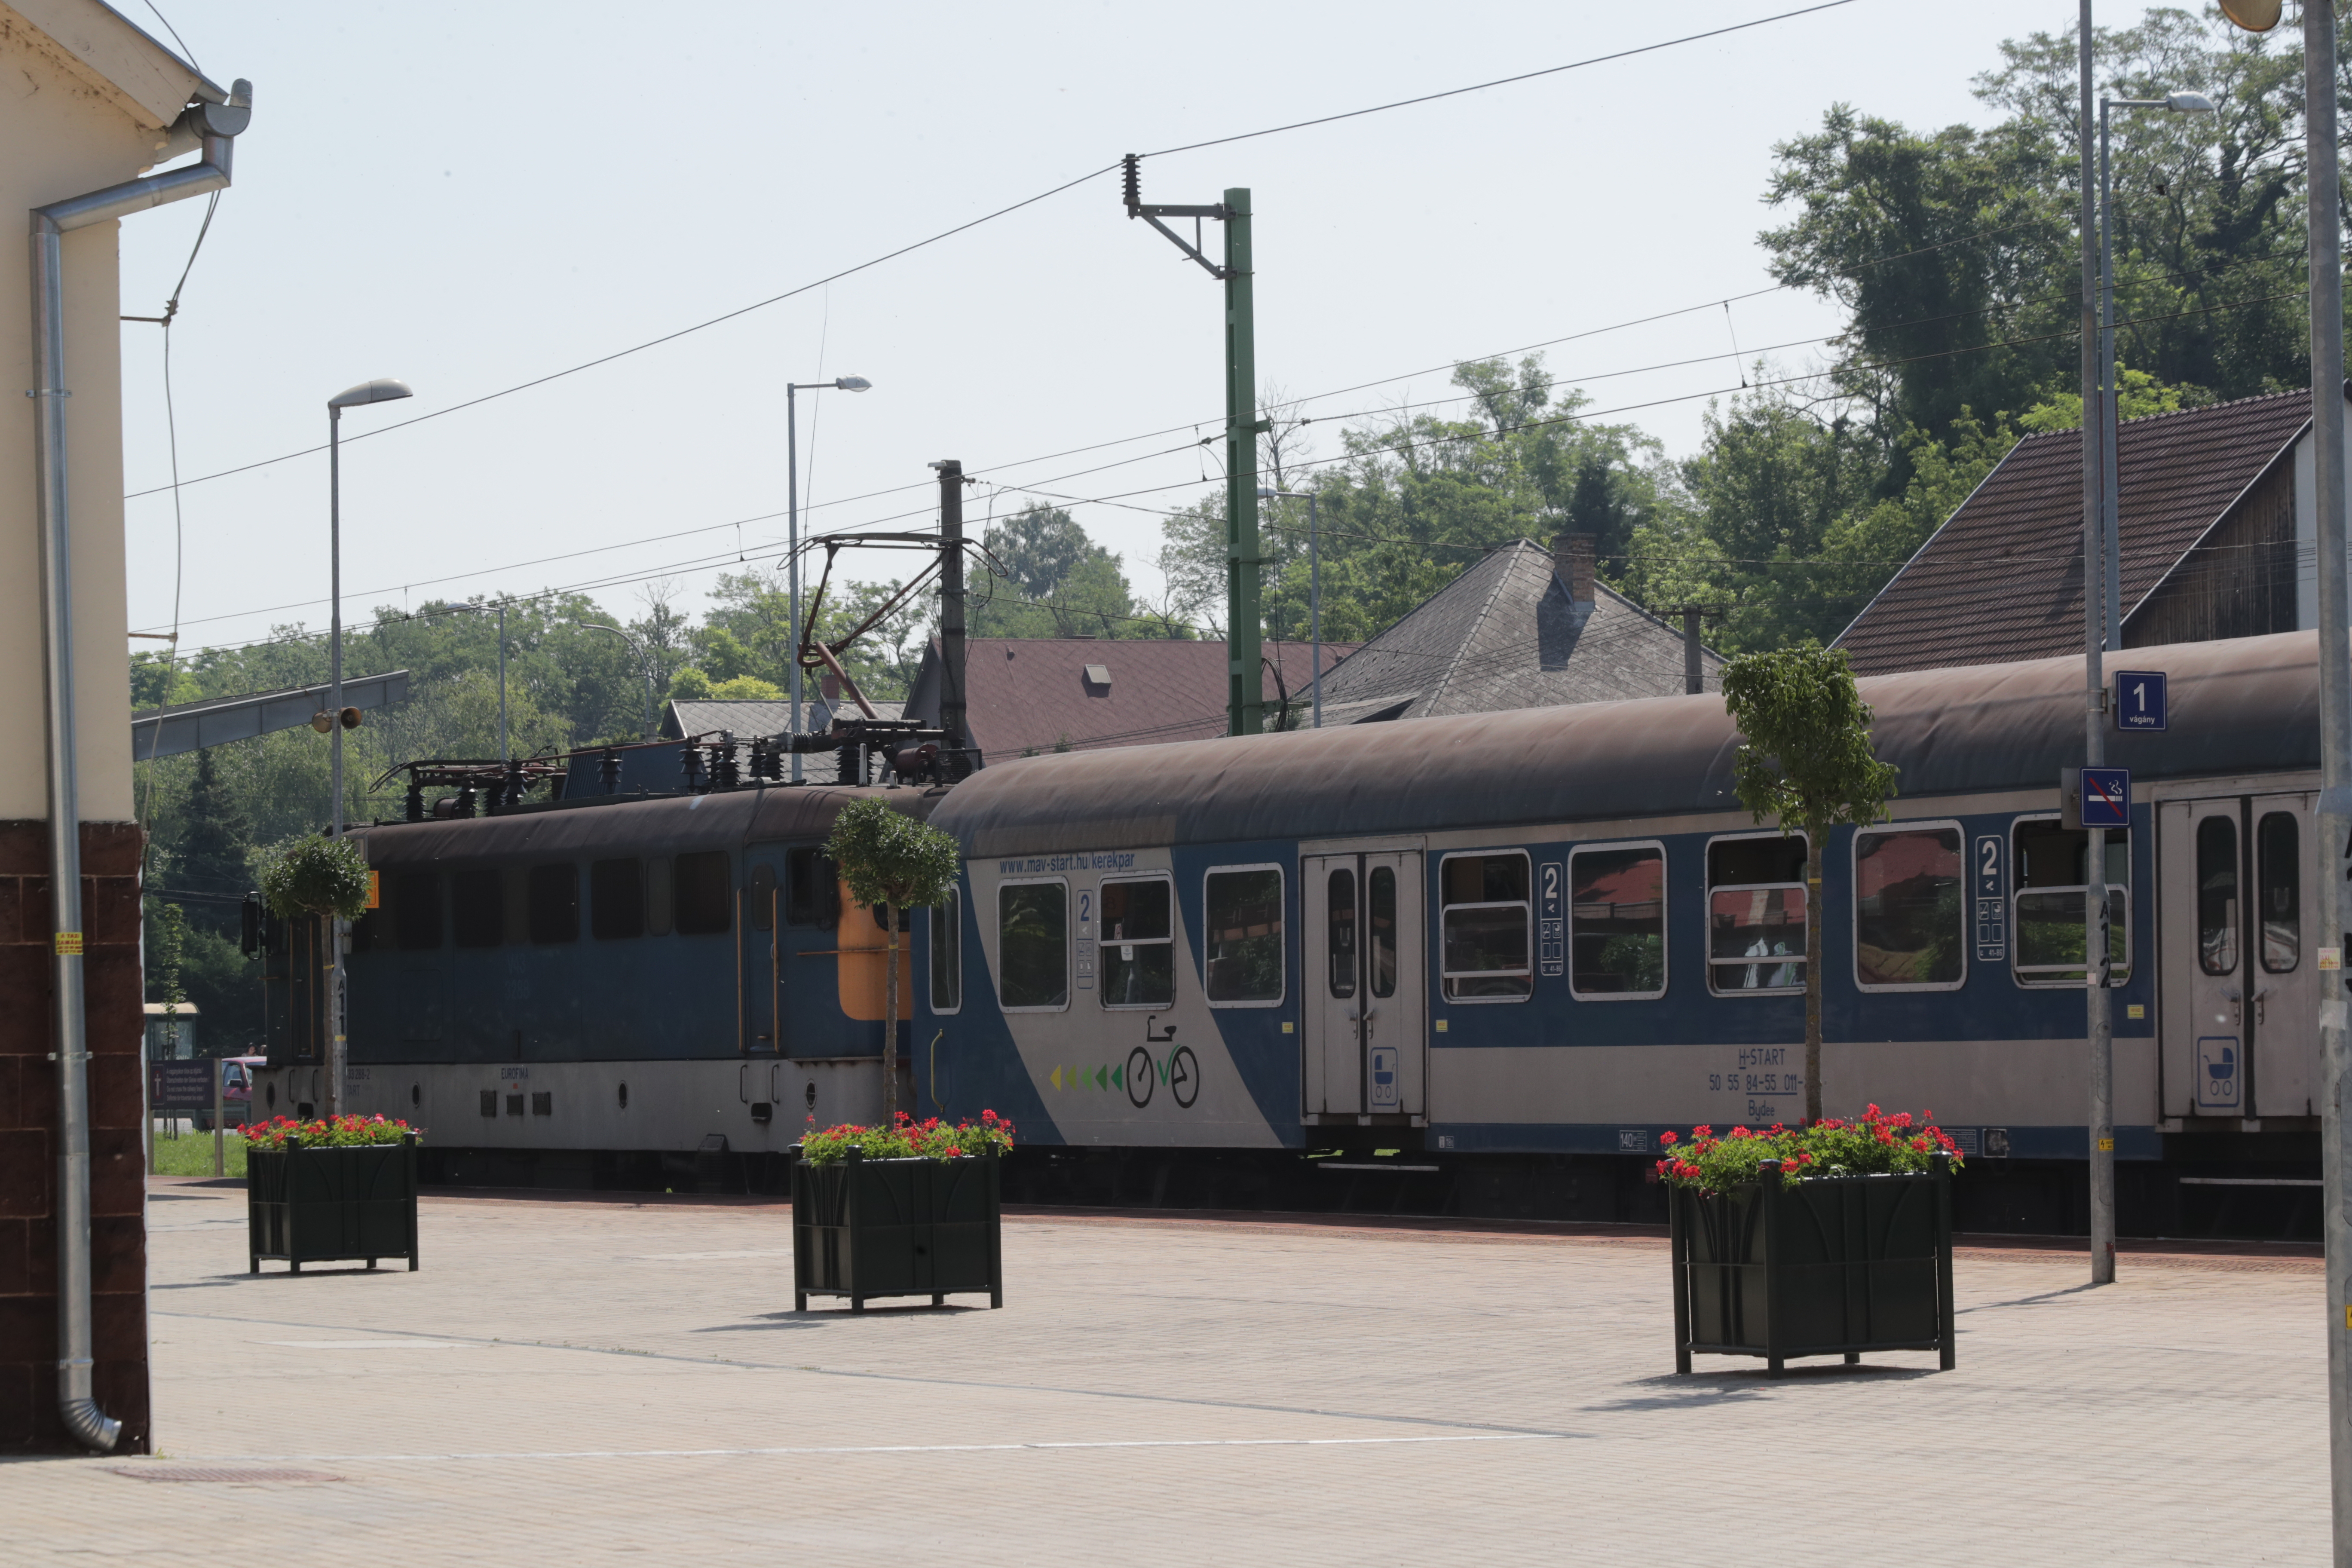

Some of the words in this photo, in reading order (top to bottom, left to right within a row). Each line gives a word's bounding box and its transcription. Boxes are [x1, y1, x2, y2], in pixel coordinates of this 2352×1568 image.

[2133, 683, 2145, 711] 1
[2129, 715, 2155, 726] vágány
[1000, 851, 1136, 874] www.mav-start.hu/kerekpar
[1981, 840, 1997, 876] 2
[1544, 867, 1558, 898] 2
[1080, 894, 1090, 922] 2
[1738, 1048, 1785, 1066] H-START
[501, 1067, 529, 1080] EUROFIMA
[1709, 1074, 1721, 1091] 50
[1727, 1074, 1739, 1091] 55
[1746, 1074, 1776, 1091] 84-55
[1748, 1099, 1775, 1121] Bydee
[1621, 1133, 1633, 1148] 140
